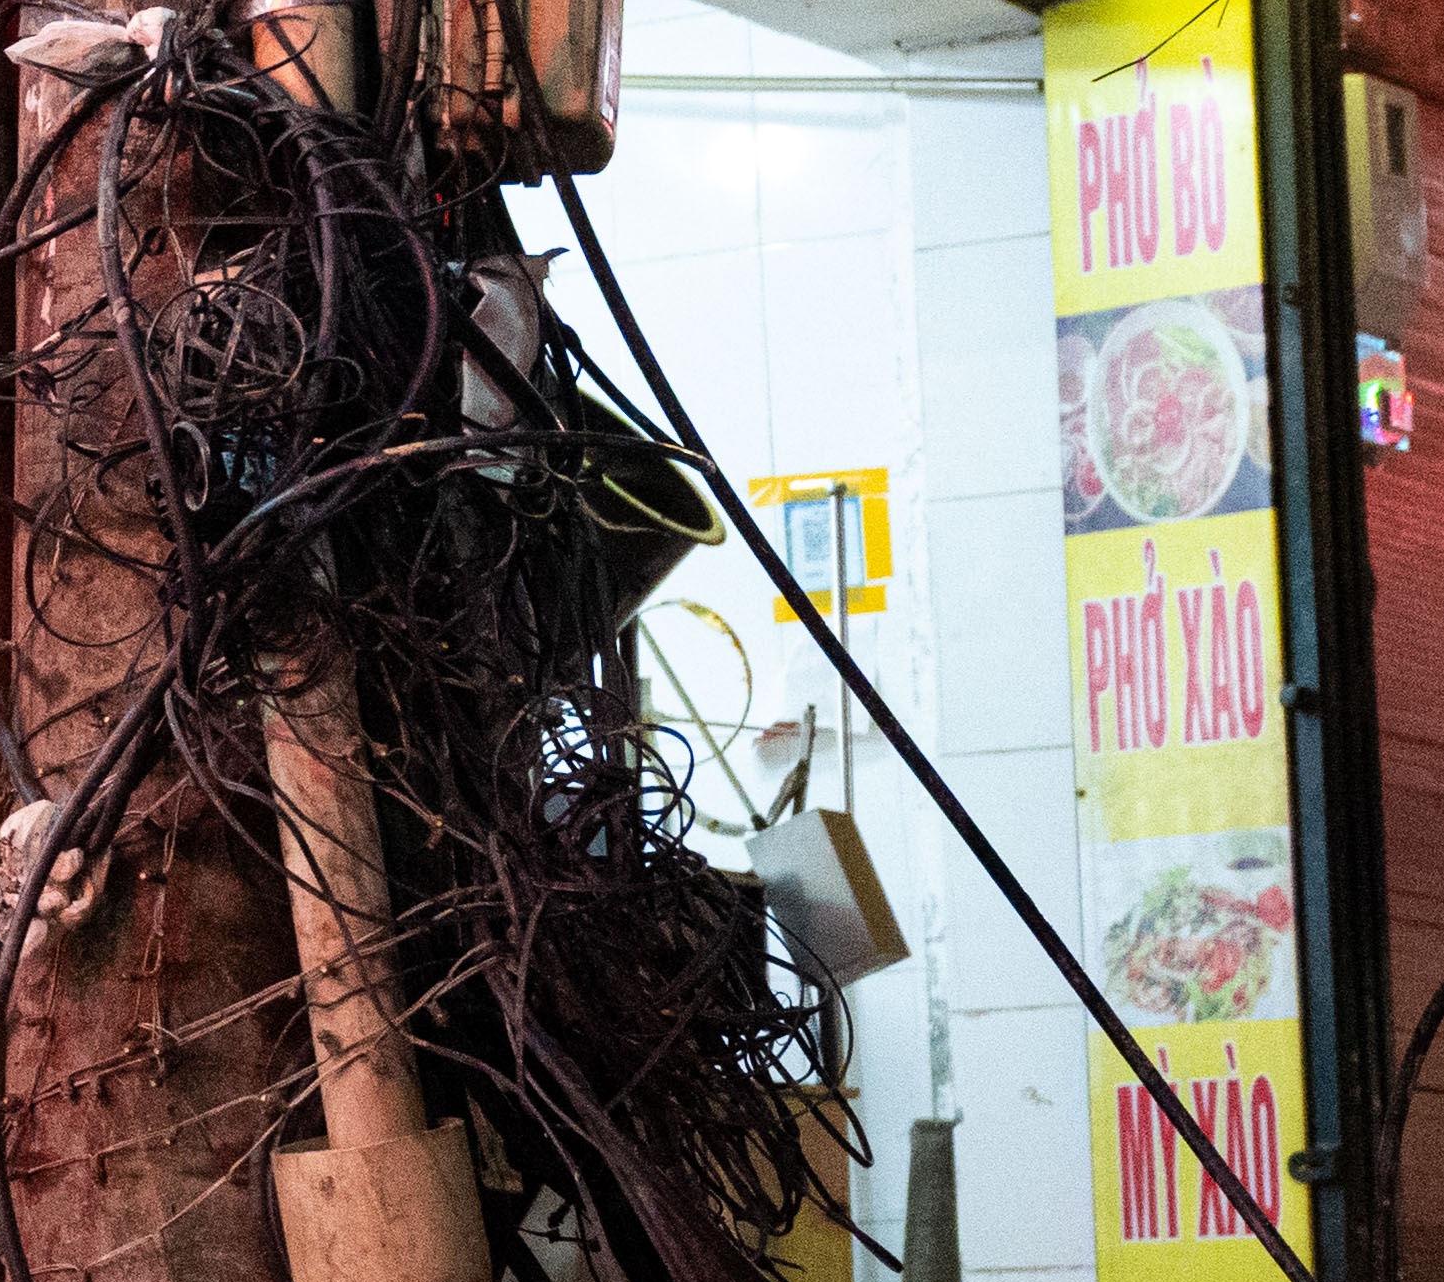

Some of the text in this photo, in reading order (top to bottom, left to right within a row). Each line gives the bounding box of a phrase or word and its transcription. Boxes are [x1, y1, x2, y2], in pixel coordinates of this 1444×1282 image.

[1079, 55, 1227, 273] PHỞ BÒ
[1084, 538, 1264, 752] PHỞ XÀO
[1192, 1042, 1280, 1237] XÀO
